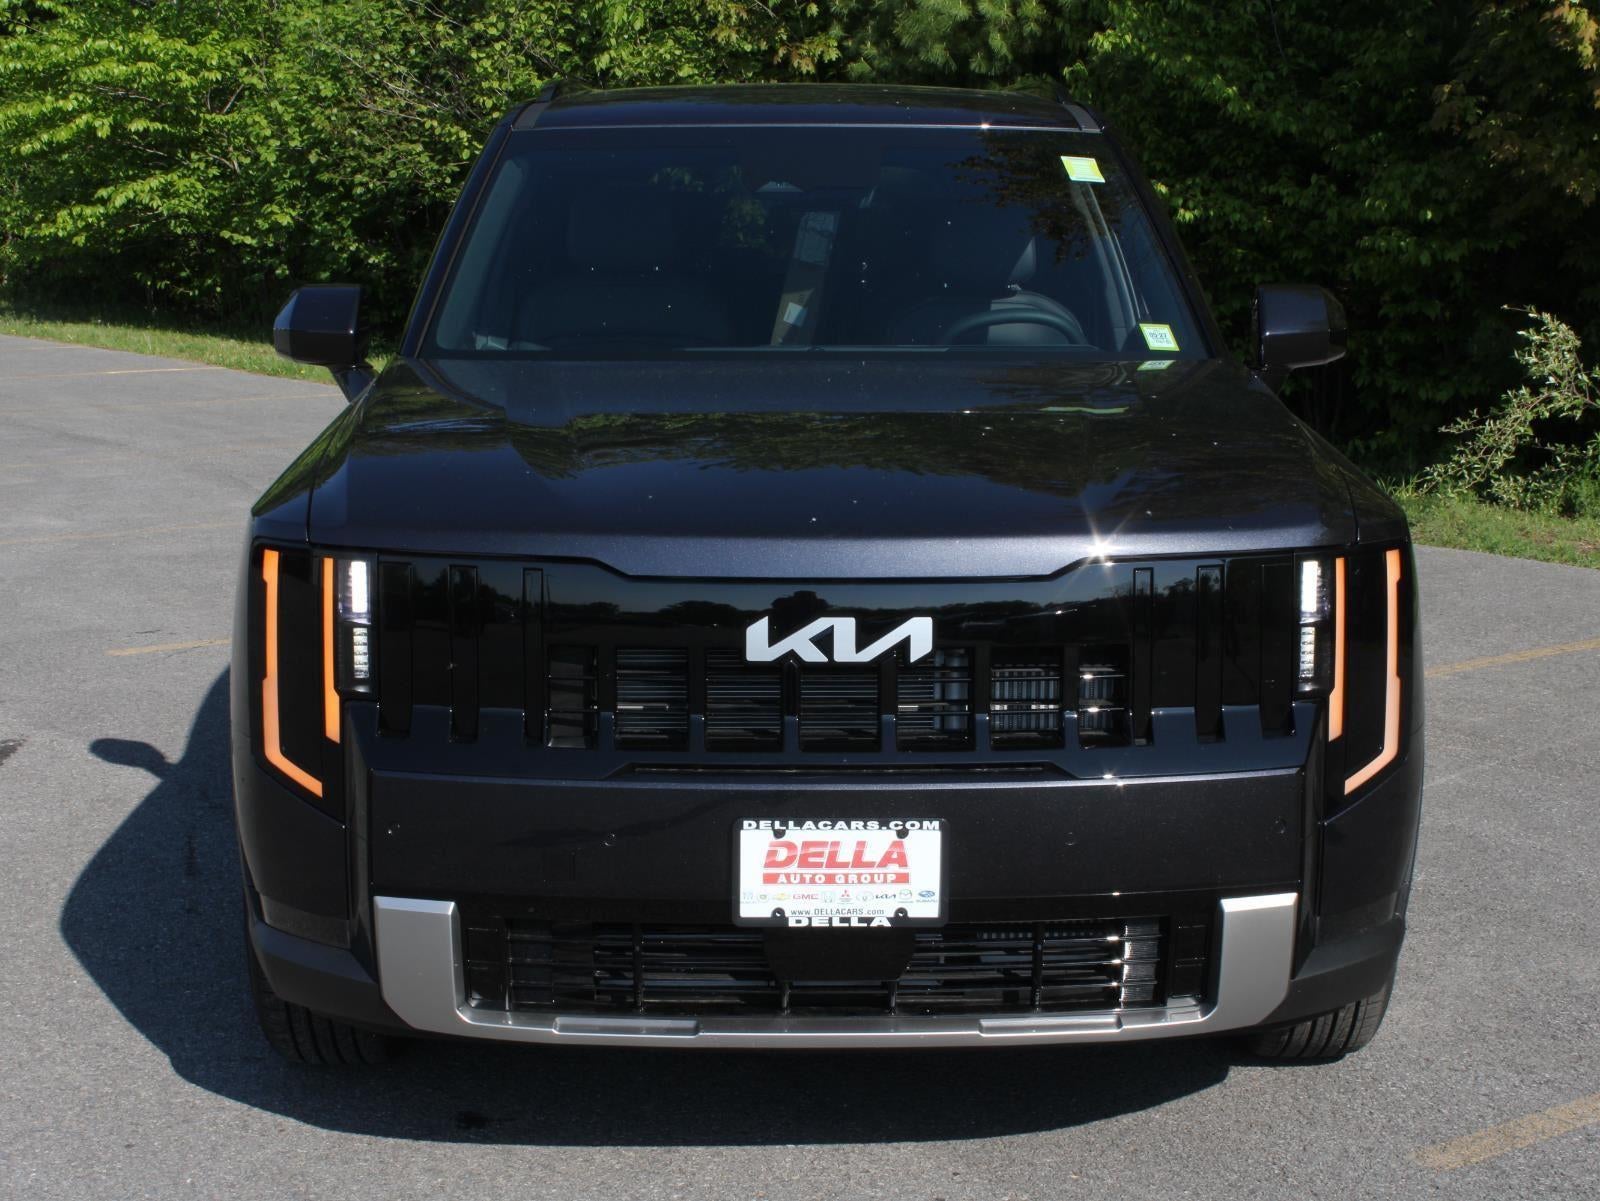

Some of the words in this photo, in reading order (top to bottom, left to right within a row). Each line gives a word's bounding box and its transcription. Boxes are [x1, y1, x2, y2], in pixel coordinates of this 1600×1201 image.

[746, 615, 933, 663] KIA
[742, 820, 940, 830] DELLACARS.COM
[763, 840, 909, 868] DELLA
[776, 873, 826, 884] AUTO
[835, 873, 897, 884] GROUP
[788, 917, 892, 927] DELLA
